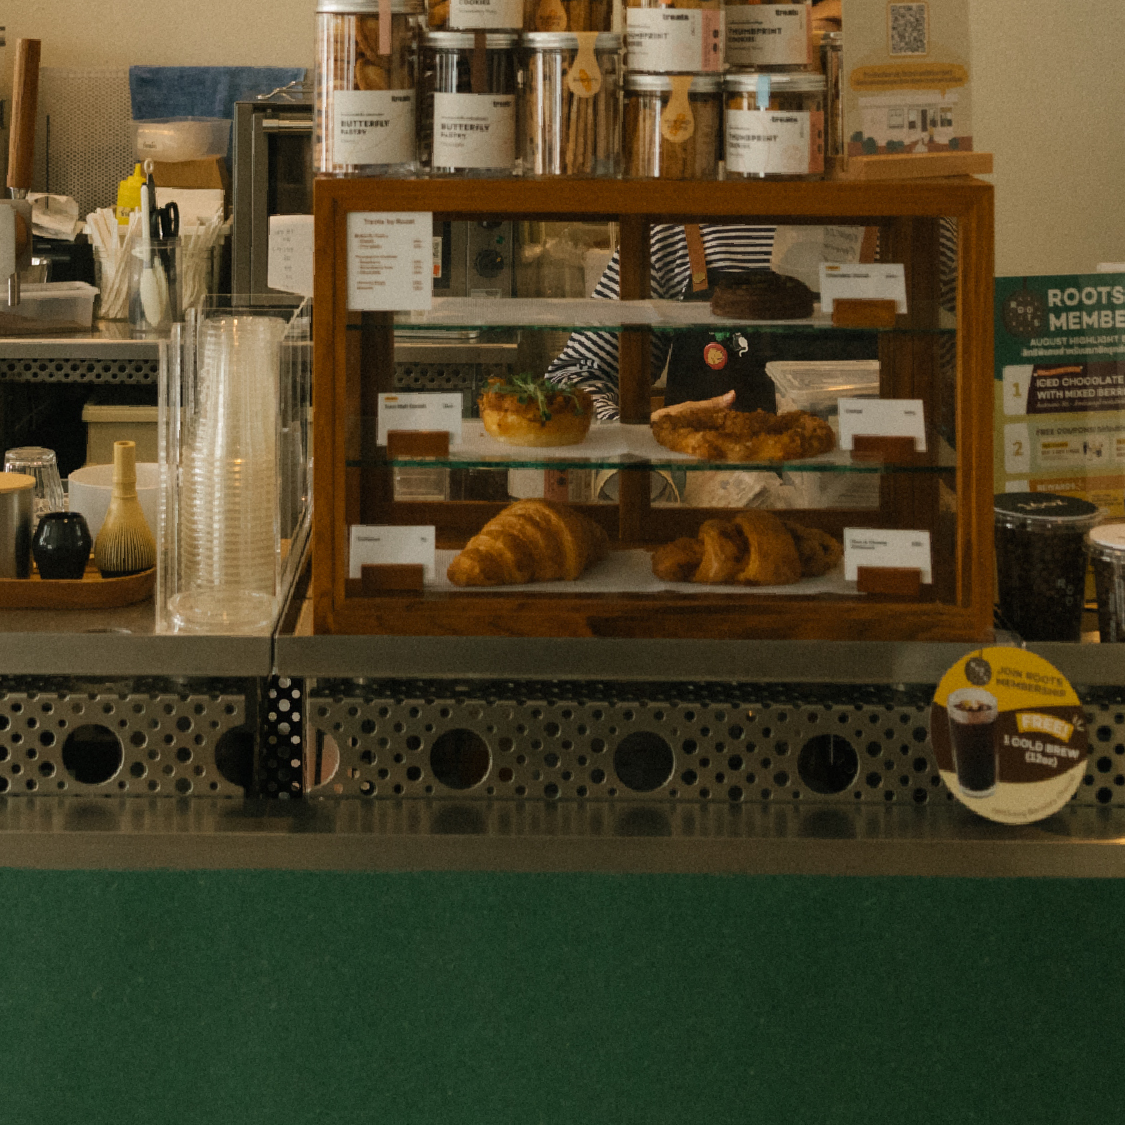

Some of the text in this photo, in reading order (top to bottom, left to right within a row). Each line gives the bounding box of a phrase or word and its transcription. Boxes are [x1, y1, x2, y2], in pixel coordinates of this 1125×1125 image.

[1049, 309, 1125, 331] MEMBE
[1030, 337, 1067, 346] AUGUST
[1036, 375, 1125, 388] ICED CHOCOLATE
[1012, 382, 1022, 398] 1
[1037, 390, 1064, 400] WITH
[1065, 389, 1096, 399] MIXED
[1012, 440, 1023, 457] 2
[1025, 671, 1064, 687] ROOTS
[1021, 713, 1070, 739] FREE!
[1011, 736, 1044, 752] COLD
[1045, 743, 1080, 759] BREW
